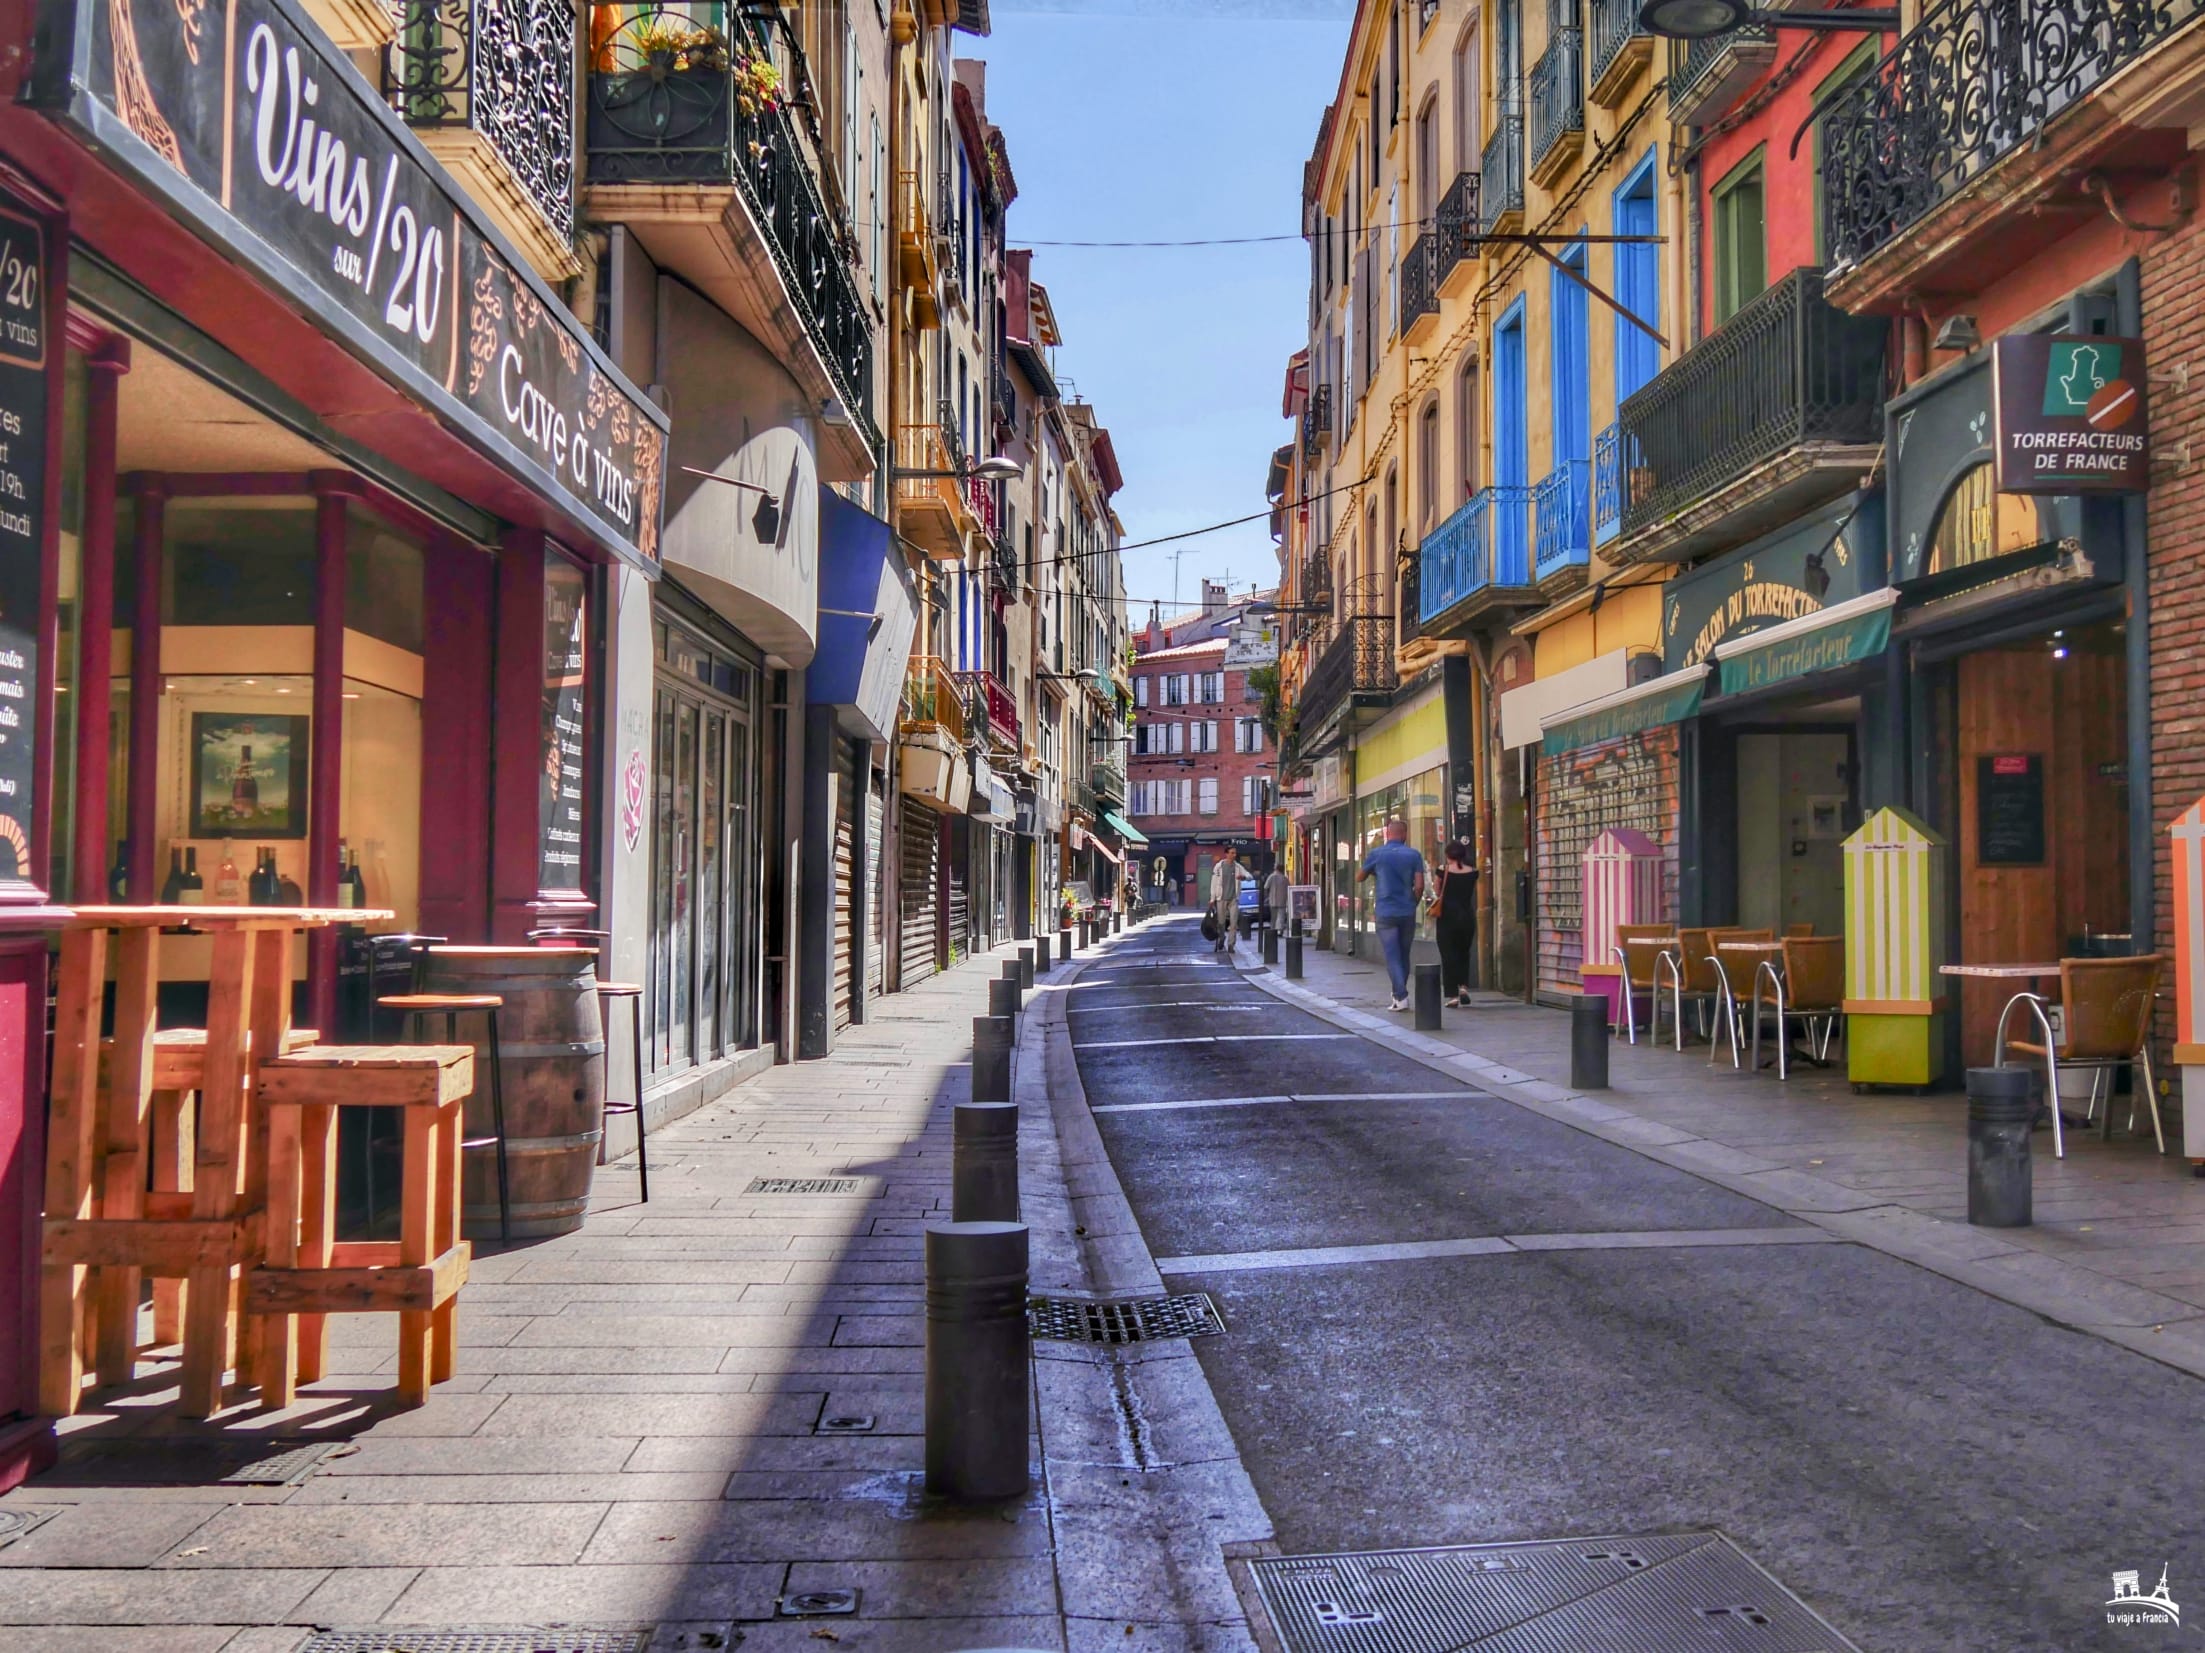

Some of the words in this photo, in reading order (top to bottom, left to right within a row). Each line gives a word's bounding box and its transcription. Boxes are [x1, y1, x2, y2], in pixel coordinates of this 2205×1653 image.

[334, 246, 363, 285] sur
[500, 343, 567, 467] Cave
[572, 410, 589, 488] à
[593, 446, 633, 526] vins
[2012, 432, 2144, 452] TORREFACTEURS
[2034, 453, 2059, 470] DE
[2065, 453, 2129, 471] FRANCE
[0, 507, 32, 538] undi
[1743, 559, 1755, 582] 26
[1693, 603, 1726, 665] SALON
[1727, 588, 1743, 628] DU
